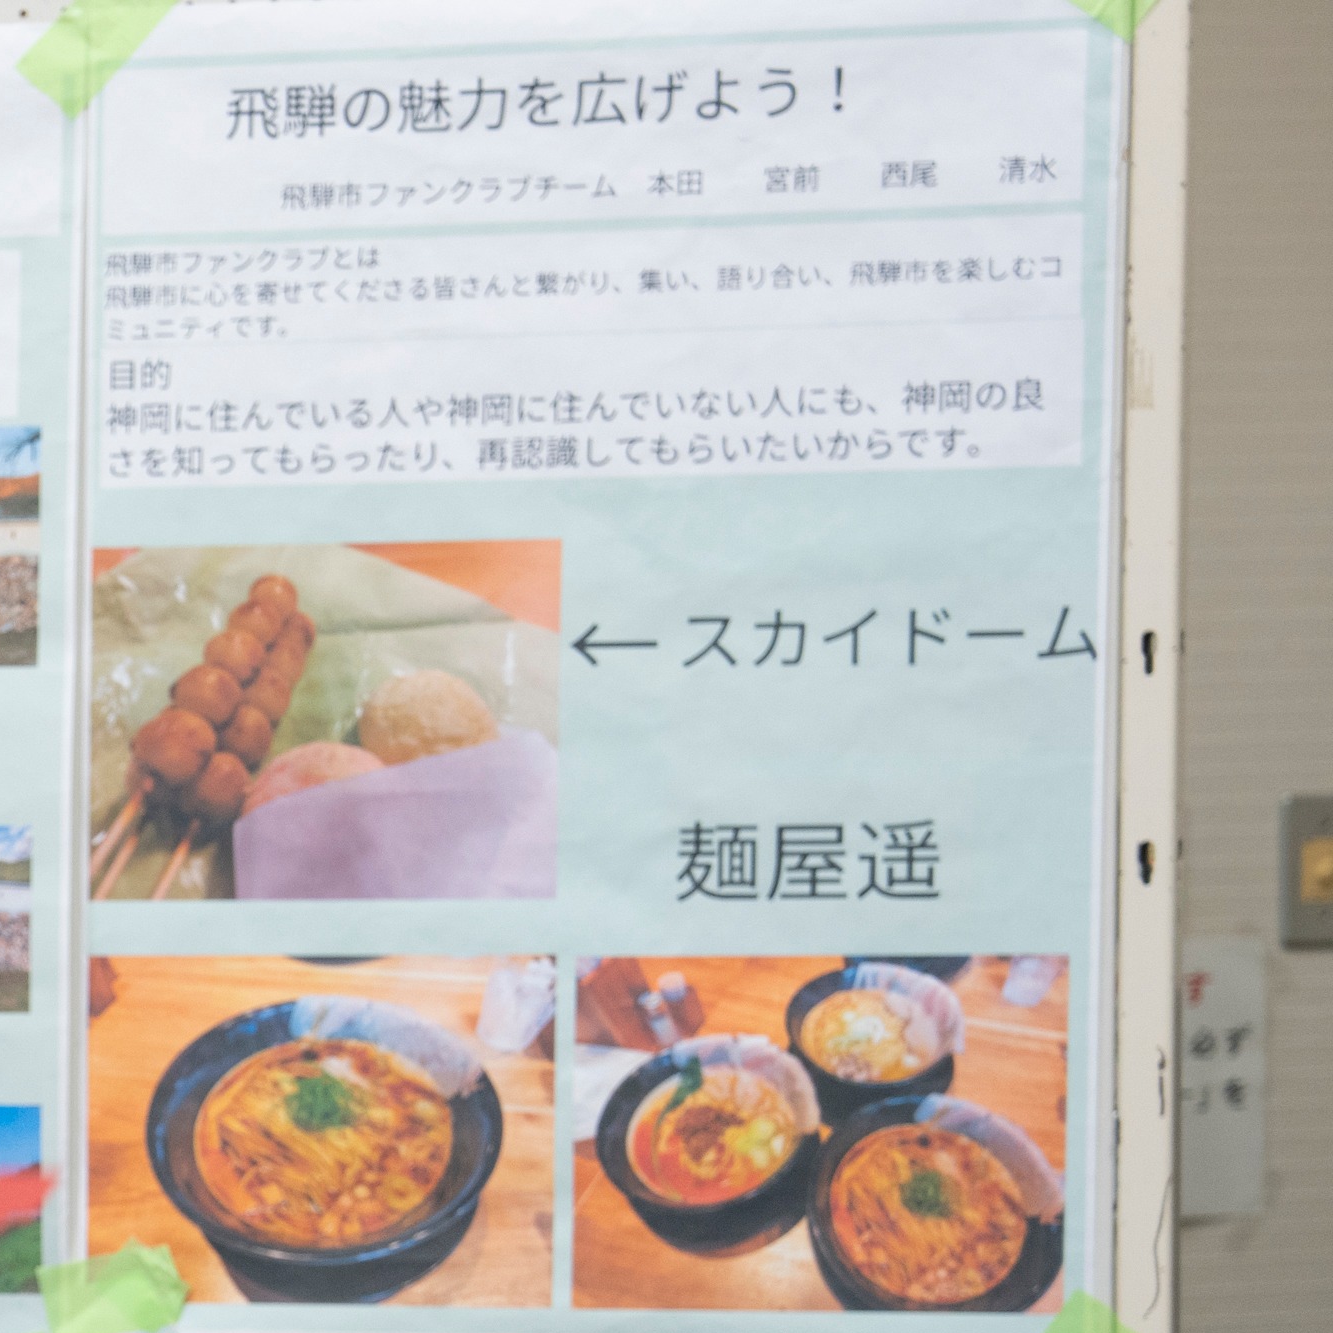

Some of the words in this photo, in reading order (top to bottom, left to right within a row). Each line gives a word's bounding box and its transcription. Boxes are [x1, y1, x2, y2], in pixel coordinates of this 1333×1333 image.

[226, 66, 843, 140] 飛騨の魅力を広げよう！
[281, 173, 616, 210] 飛騨市ファンクラブチーム
[647, 169, 704, 196] 本田
[764, 164, 820, 193] 宮前
[881, 160, 938, 190] 西尾
[999, 154, 1056, 184] 清水
[104, 246, 381, 276] 飛騨市ファンクラブとは
[107, 315, 290, 341] ミュニティです。
[108, 358, 172, 391] 目的
[106, 377, 1046, 435] 神岡に住んでいる人や神岡に住んでいない人にも、神岡の良
[109, 426, 982, 478] さを知ってもらったり、再認識してもらいたいからです。
[682, 606, 1099, 668] スカイドーム
[676, 819, 942, 902] 麺屋遥
